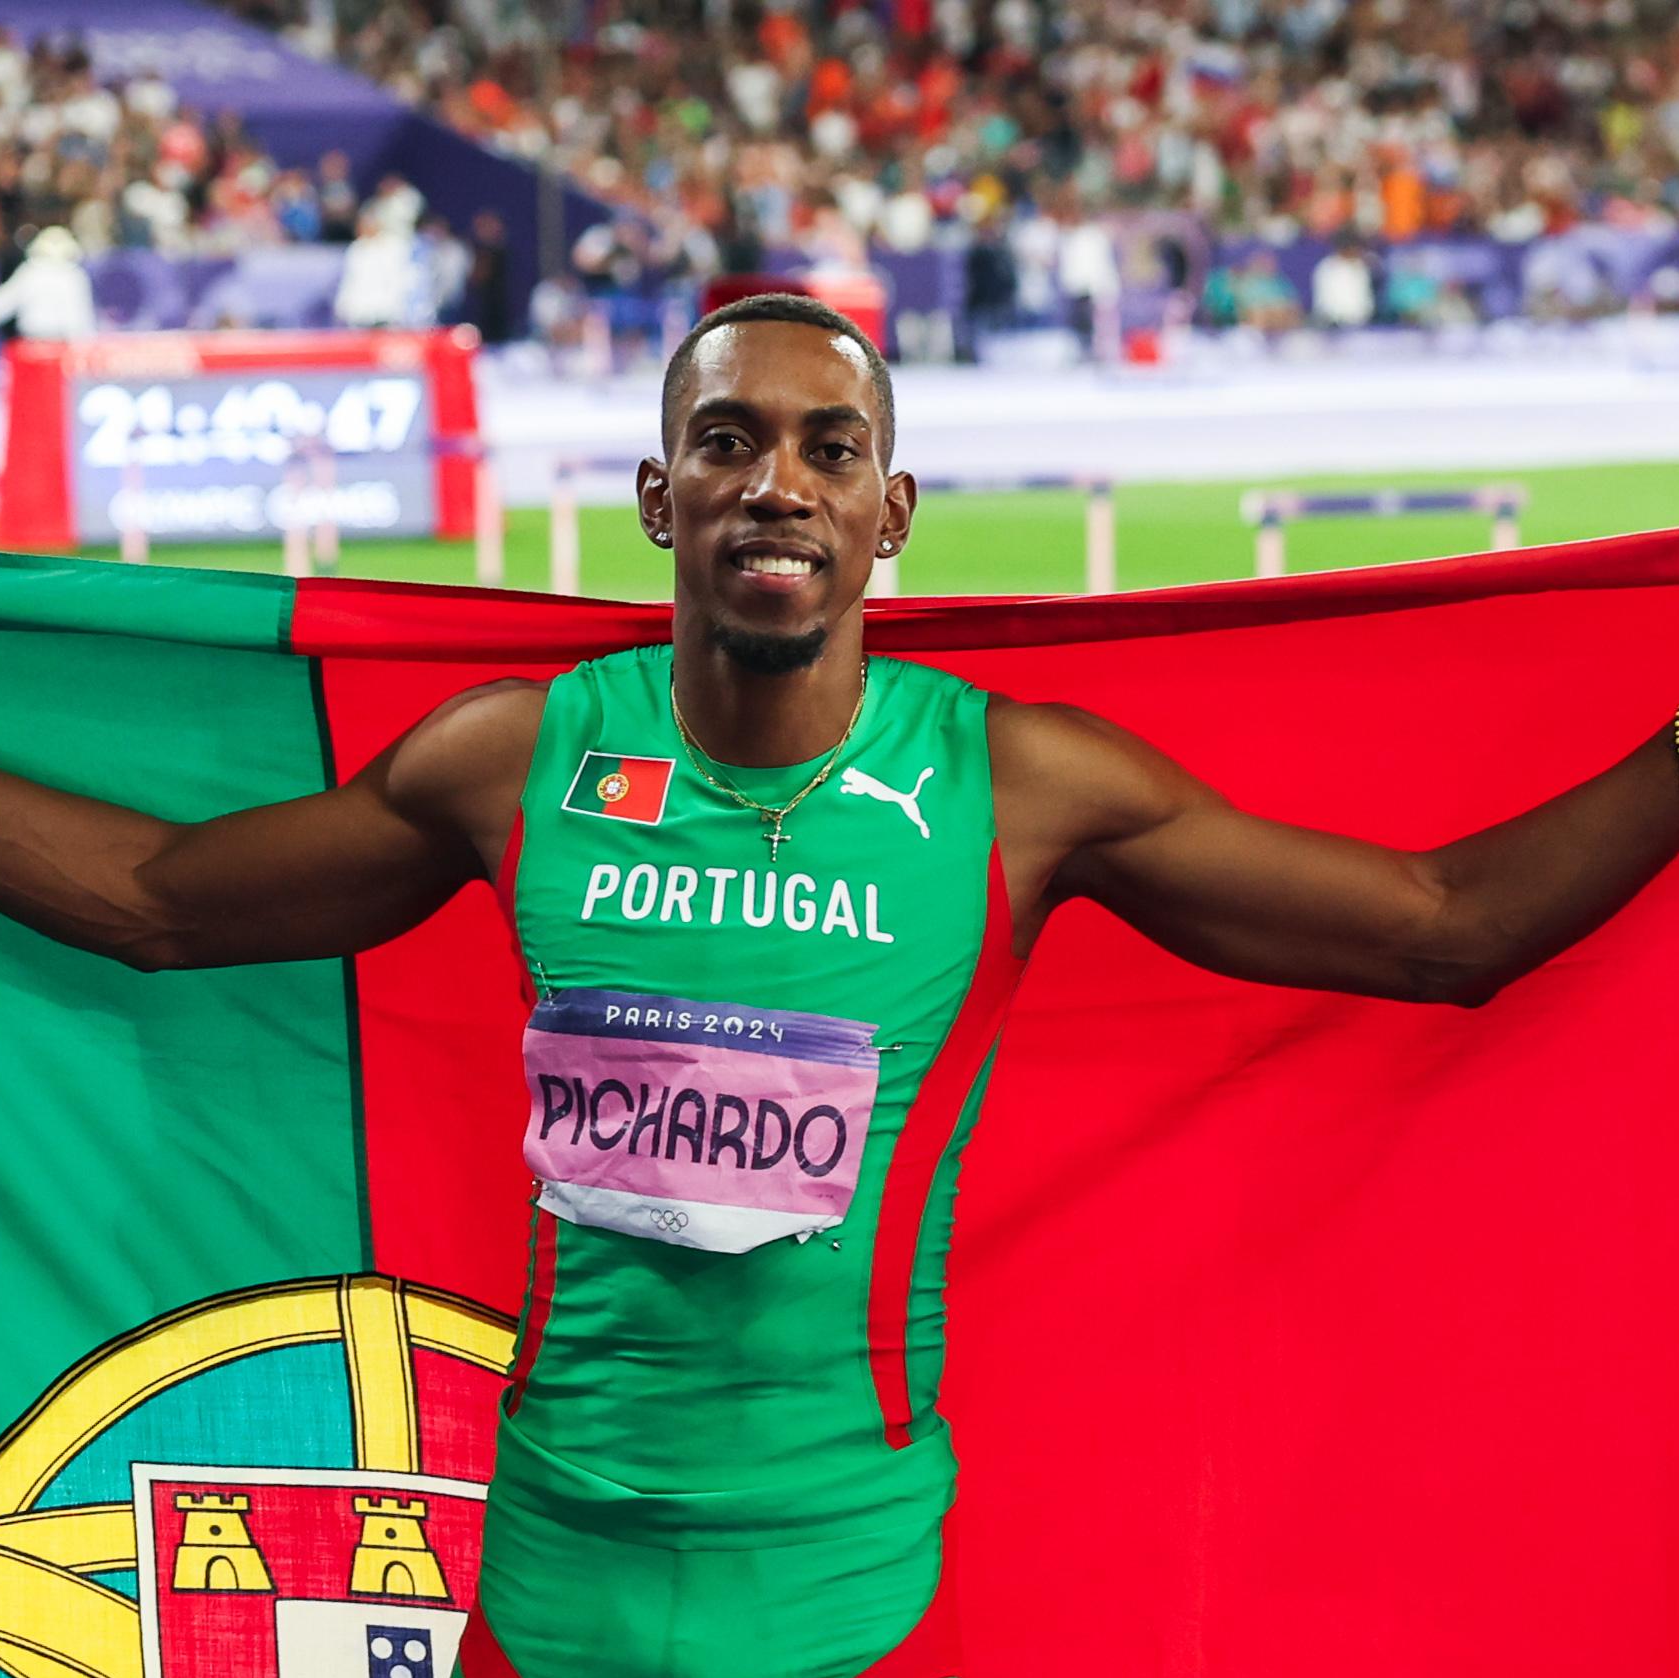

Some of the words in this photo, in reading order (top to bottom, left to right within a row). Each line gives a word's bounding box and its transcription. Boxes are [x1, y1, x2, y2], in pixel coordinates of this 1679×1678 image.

[581, 863, 895, 944] PORTUGAL
[606, 1005, 692, 1030] PARIS
[703, 1014, 784, 1042] 2024
[538, 1073, 847, 1178] PICHARDO
